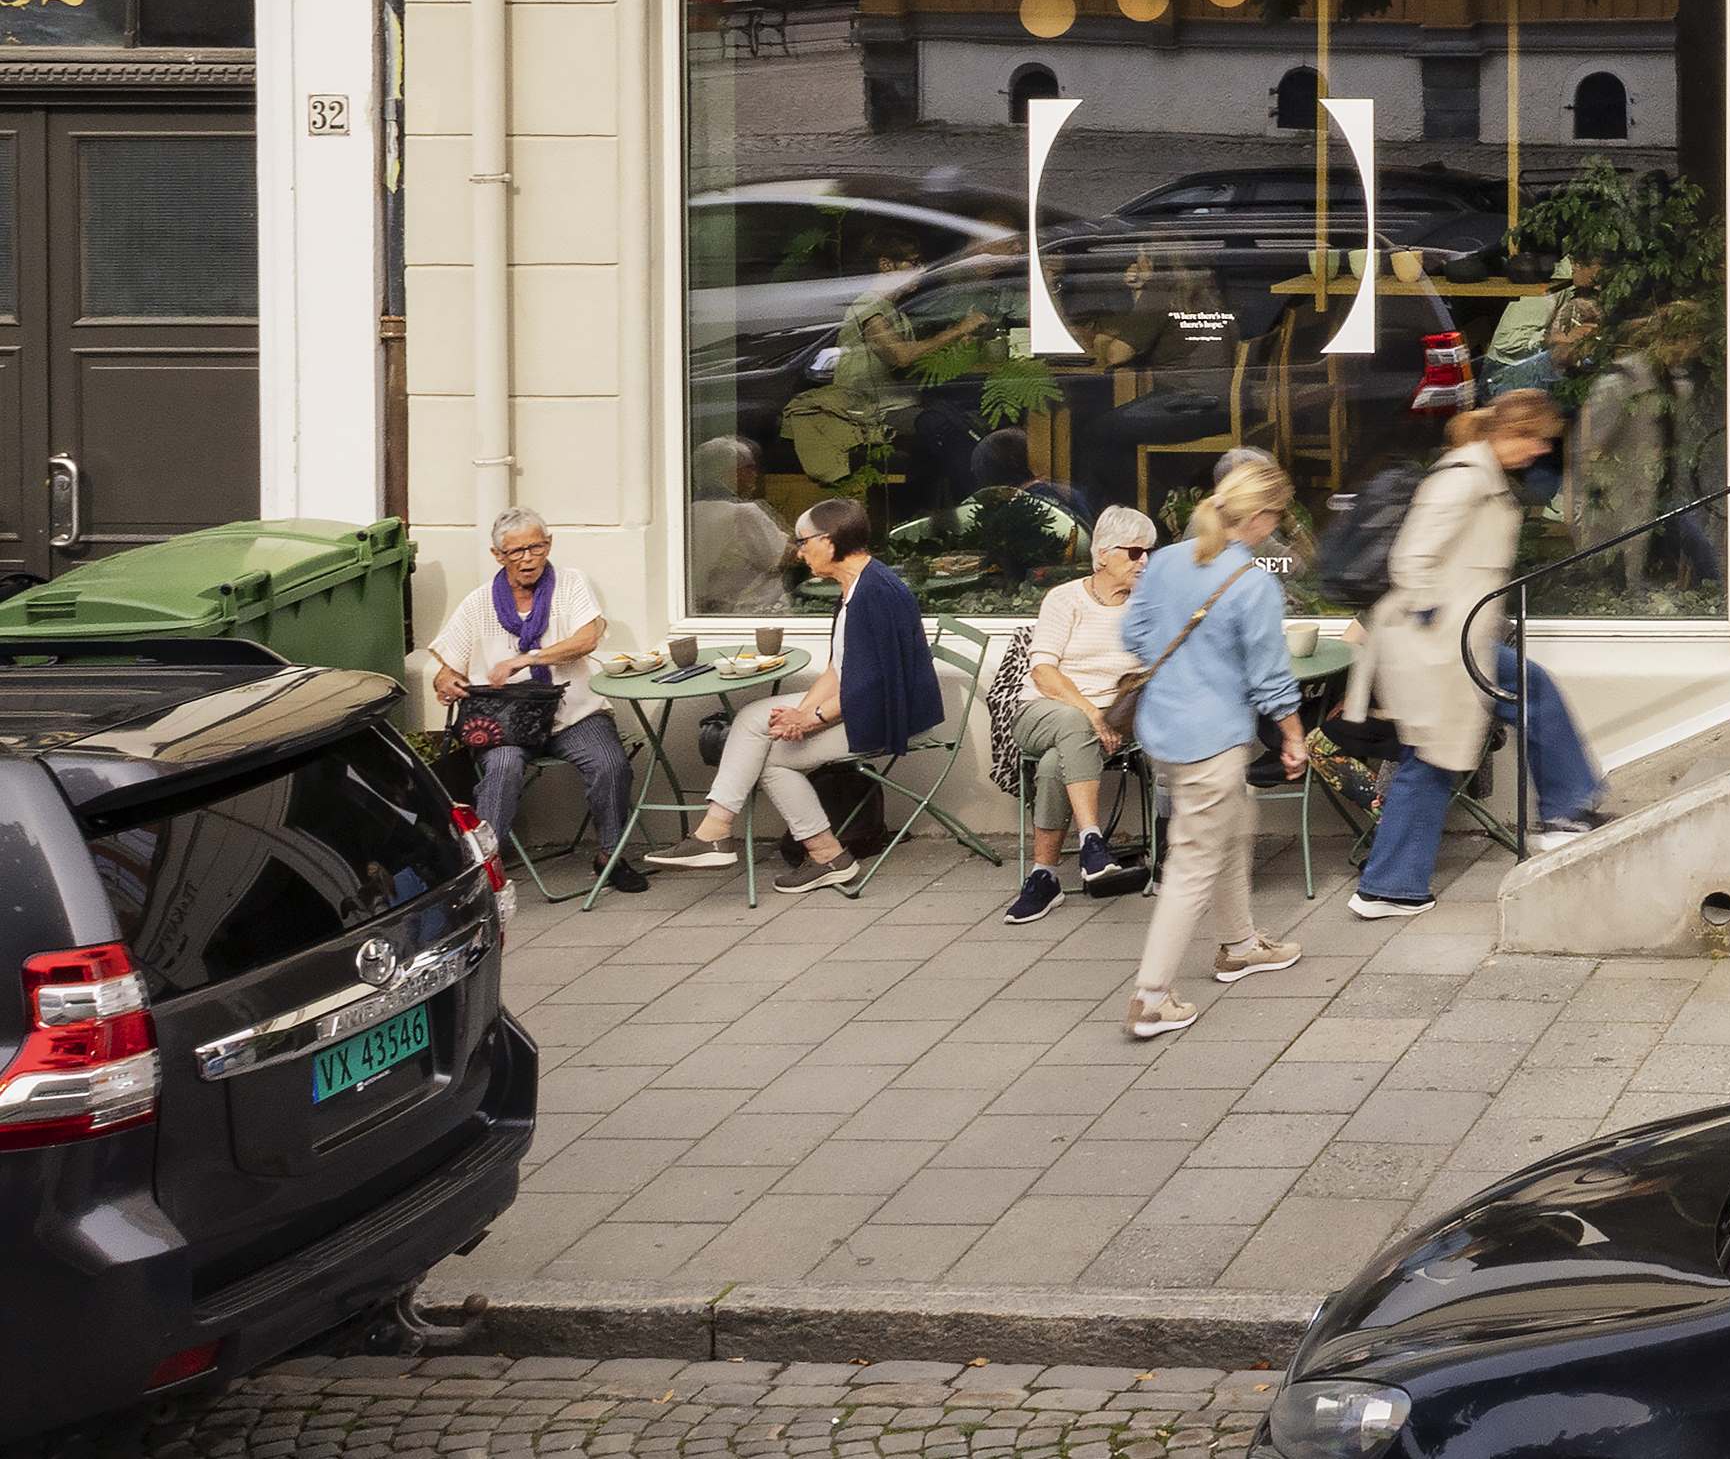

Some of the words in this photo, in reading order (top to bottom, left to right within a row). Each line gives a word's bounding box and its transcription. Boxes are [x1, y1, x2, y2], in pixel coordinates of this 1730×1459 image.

[311, 100, 346, 130] 32
[320, 1046, 353, 1092] VX
[361, 1011, 425, 1071] 43546
